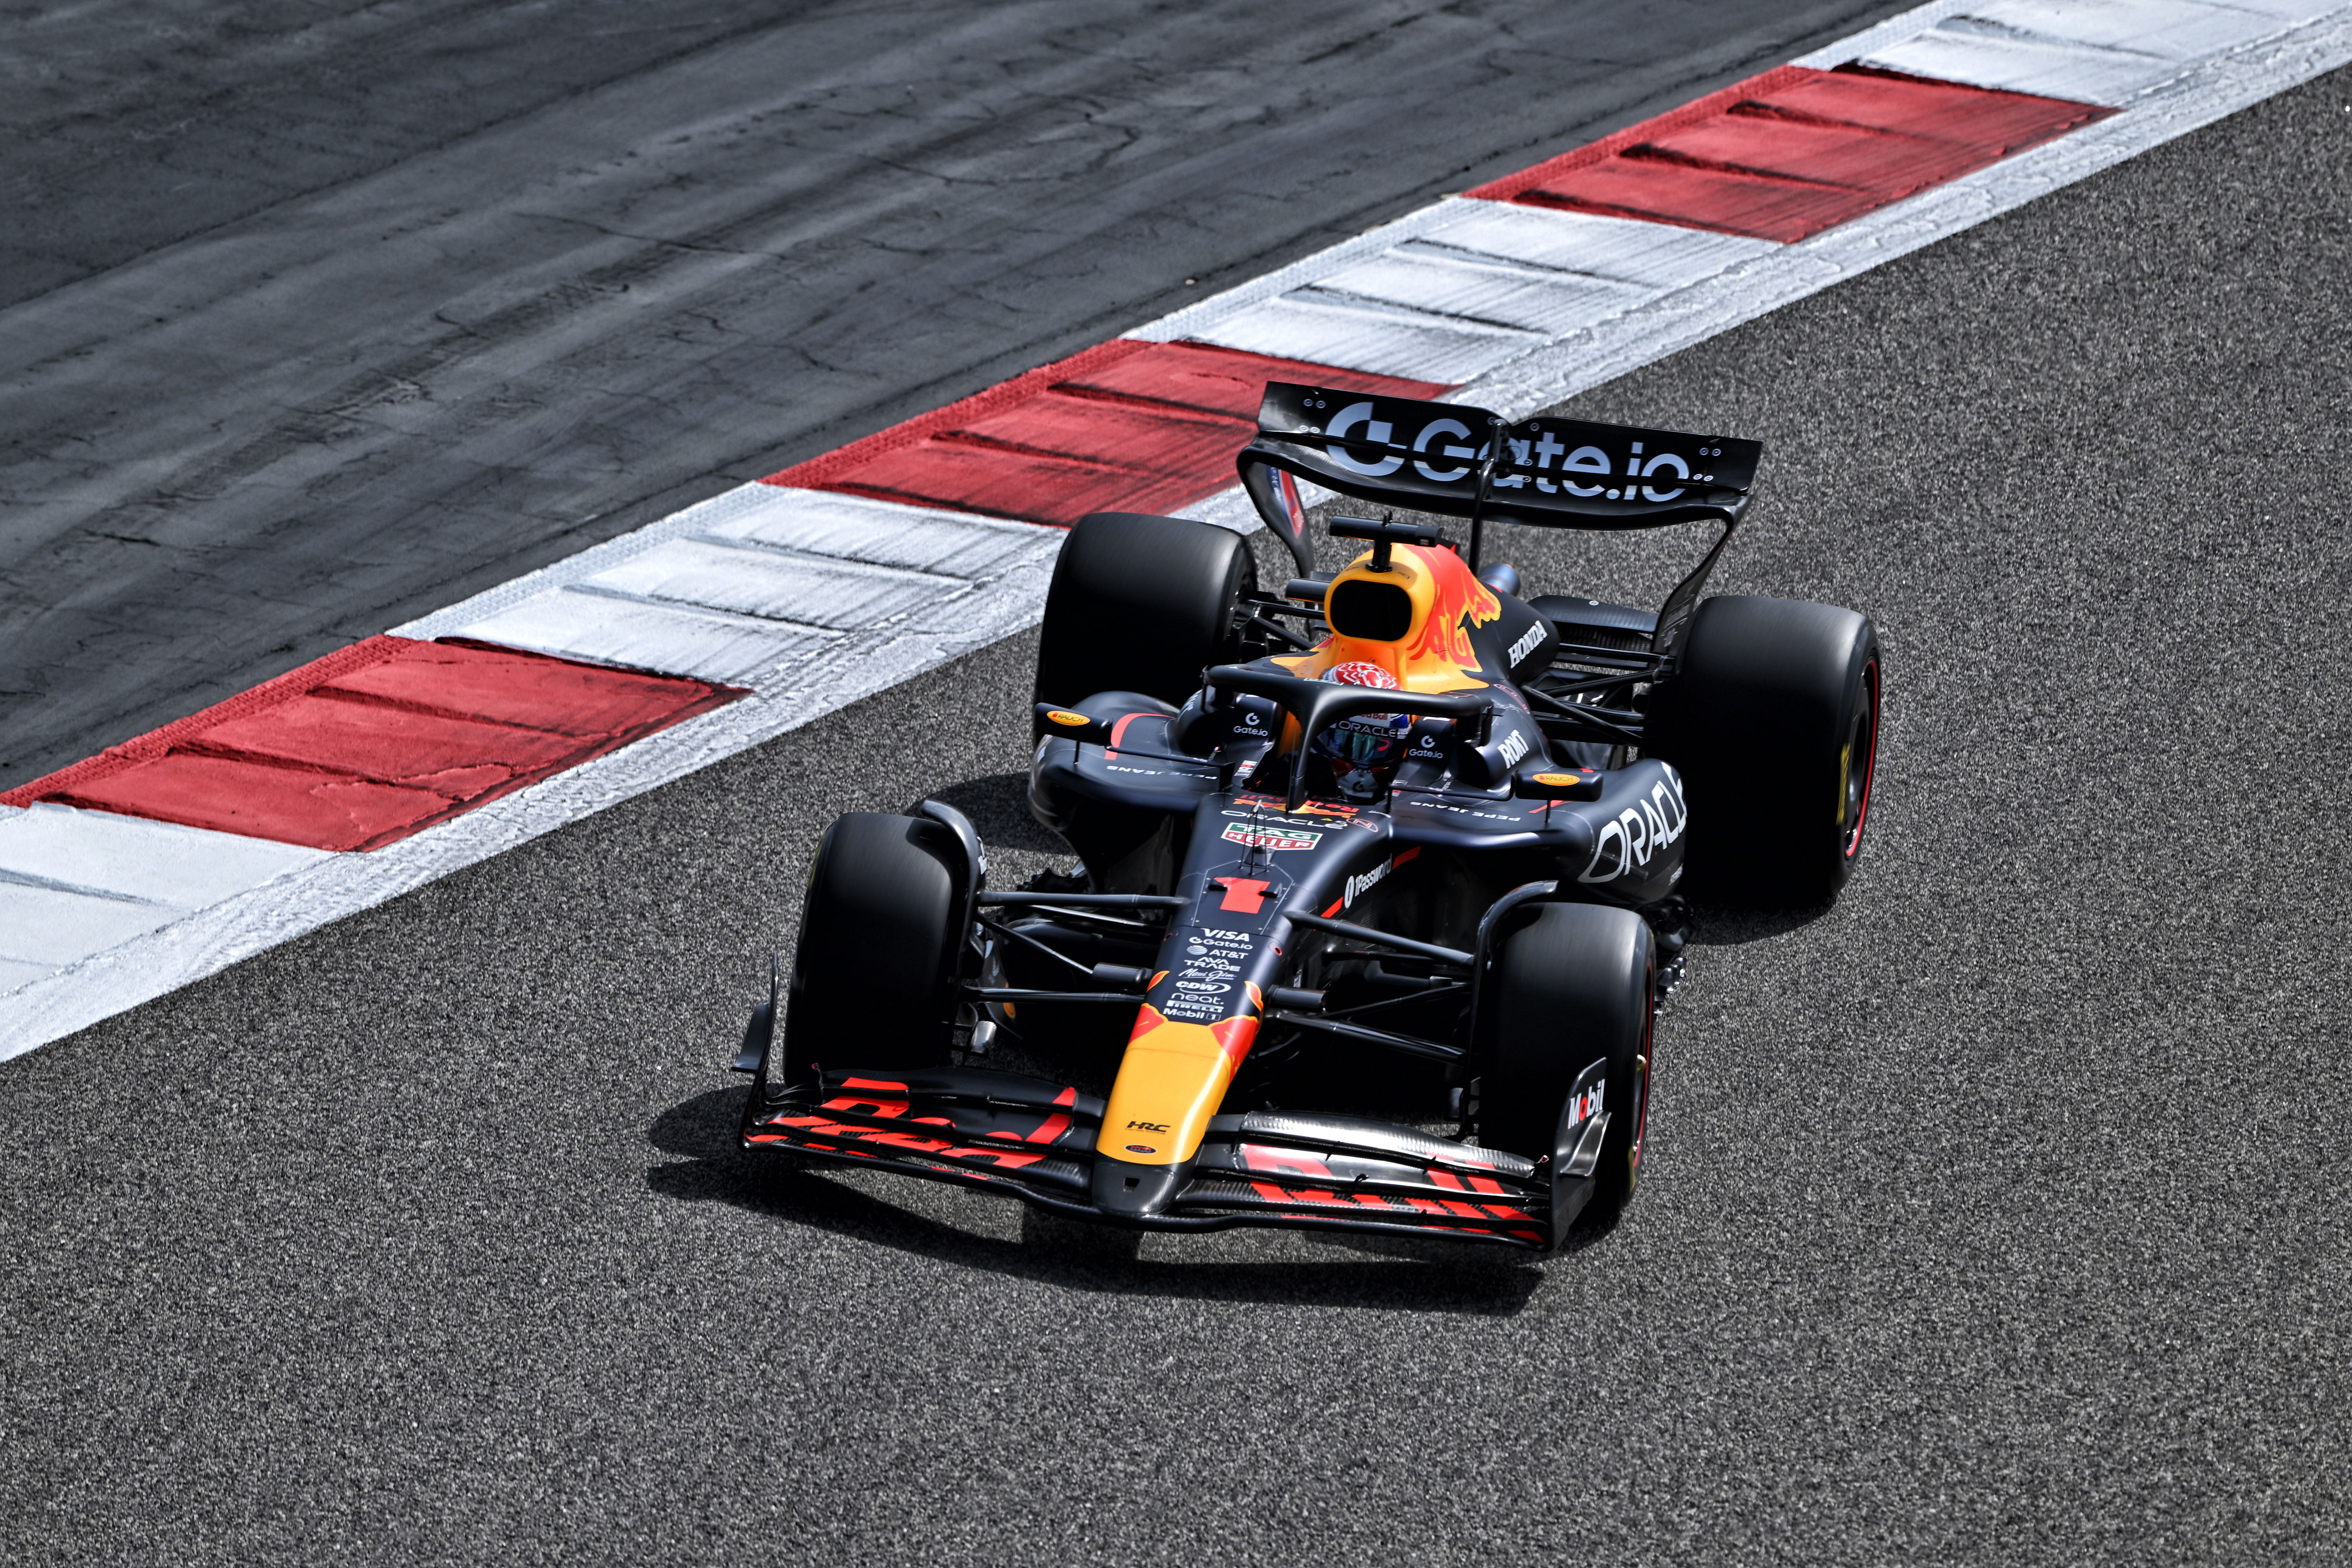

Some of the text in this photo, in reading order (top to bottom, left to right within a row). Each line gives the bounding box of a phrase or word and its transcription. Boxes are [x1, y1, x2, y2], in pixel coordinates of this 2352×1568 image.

[1413, 418, 1689, 501] Gate.io
[1508, 620, 1548, 669] HONDA
[1058, 713, 1084, 722] RAUCH
[1233, 726, 1268, 736] Gate.io
[1338, 720, 1397, 737] ORACLE
[1409, 749, 1443, 759] Gate.io
[1497, 730, 1529, 769] ROKT
[1106, 766, 1165, 775] JEANS
[1410, 802, 1521, 821] PEPE JEANS
[1221, 810, 1345, 829] ORACLE
[1236, 825, 1313, 840] TAG
[1229, 833, 1311, 848] HEUER
[1355, 853, 1392, 897] 1Password
[1214, 877, 1270, 914] 1
[1200, 928, 1250, 942] VISA
[1203, 939, 1253, 950] Gate.io
[1209, 949, 1249, 959] AT&T
[1183, 960, 1241, 972] TRADE
[1178, 968, 1237, 982] Maui Jim
[1176, 981, 1219, 991] CDW
[1163, 1008, 1205, 1018] Mobil
[1166, 1000, 1224, 1013] PIRELLI
[1568, 1079, 1605, 1129] Mobil
[1127, 1121, 1171, 1132] HRC
